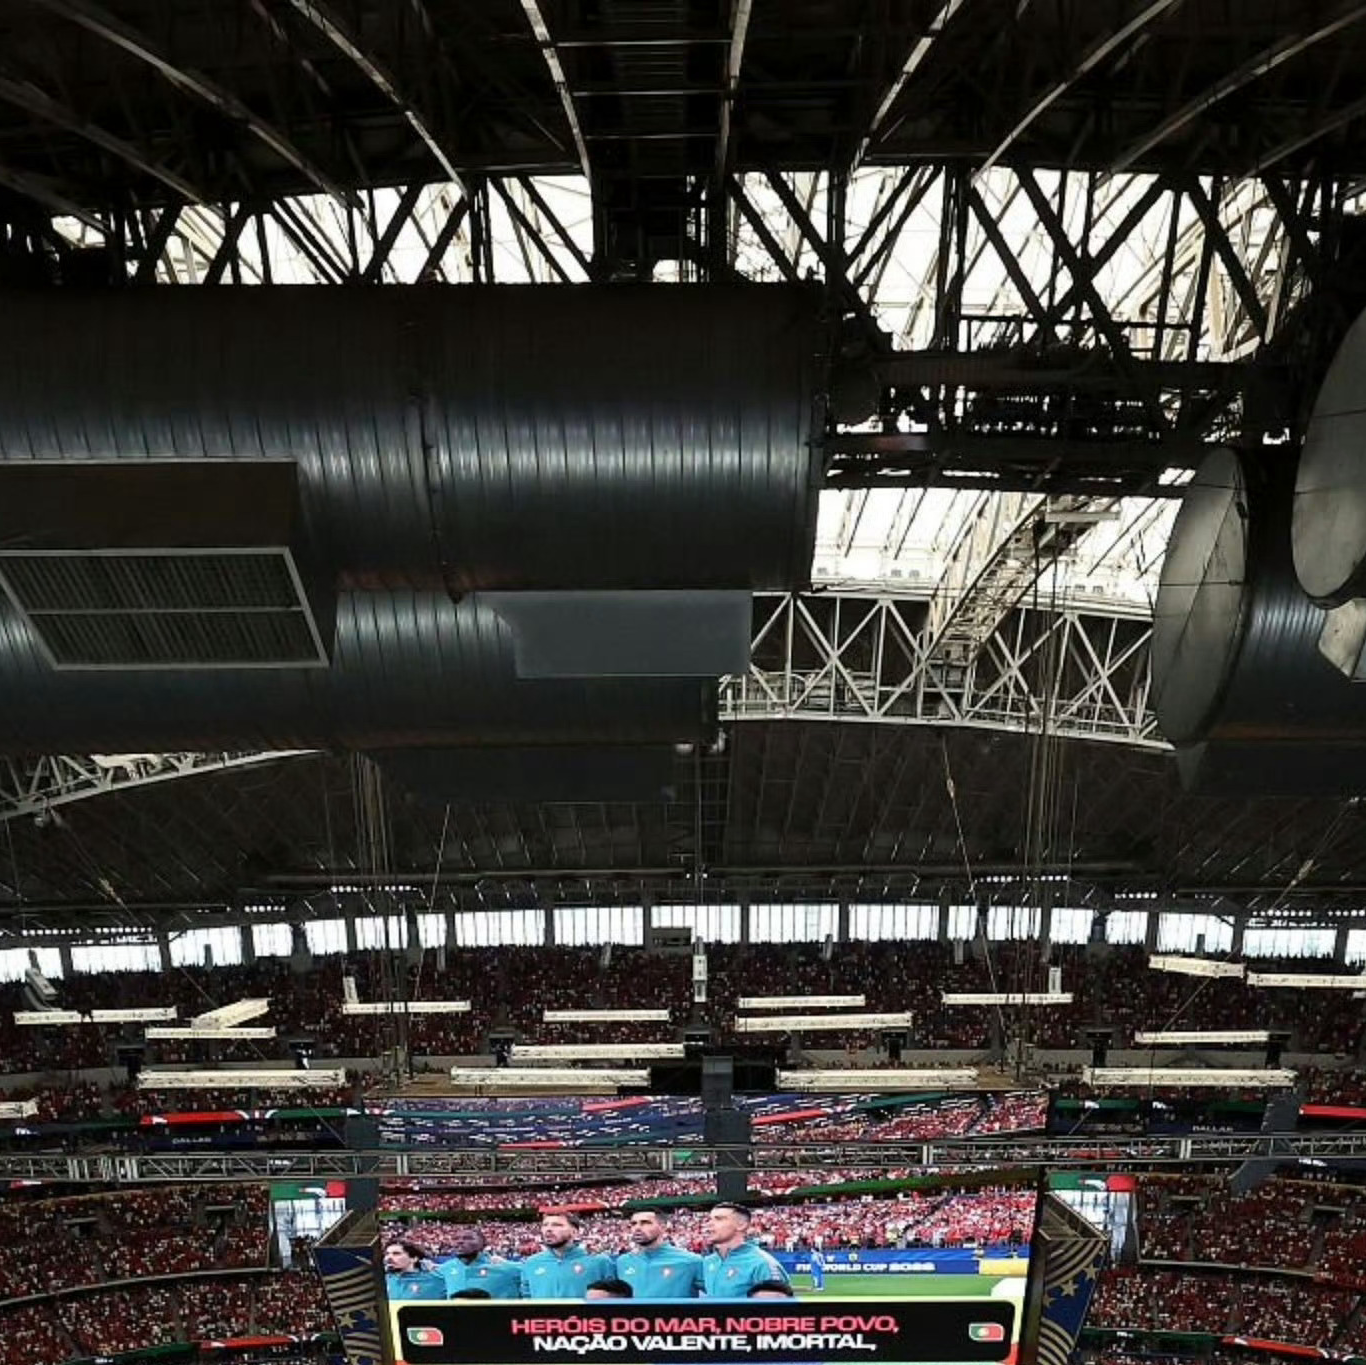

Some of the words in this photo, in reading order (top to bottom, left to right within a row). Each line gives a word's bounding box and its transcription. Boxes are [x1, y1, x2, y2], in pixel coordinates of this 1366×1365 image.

[510, 1315, 607, 1335] HERÓIS
[610, 1317, 650, 1334] DO
[653, 1317, 722, 1336] MAR,
[725, 1316, 816, 1333] NOBRE
[820, 1315, 900, 1334] POVO,
[532, 1333, 628, 1355] NAÇÃO
[630, 1334, 752, 1353] VALENTE,
[755, 1333, 877, 1352] IMORTAL,
